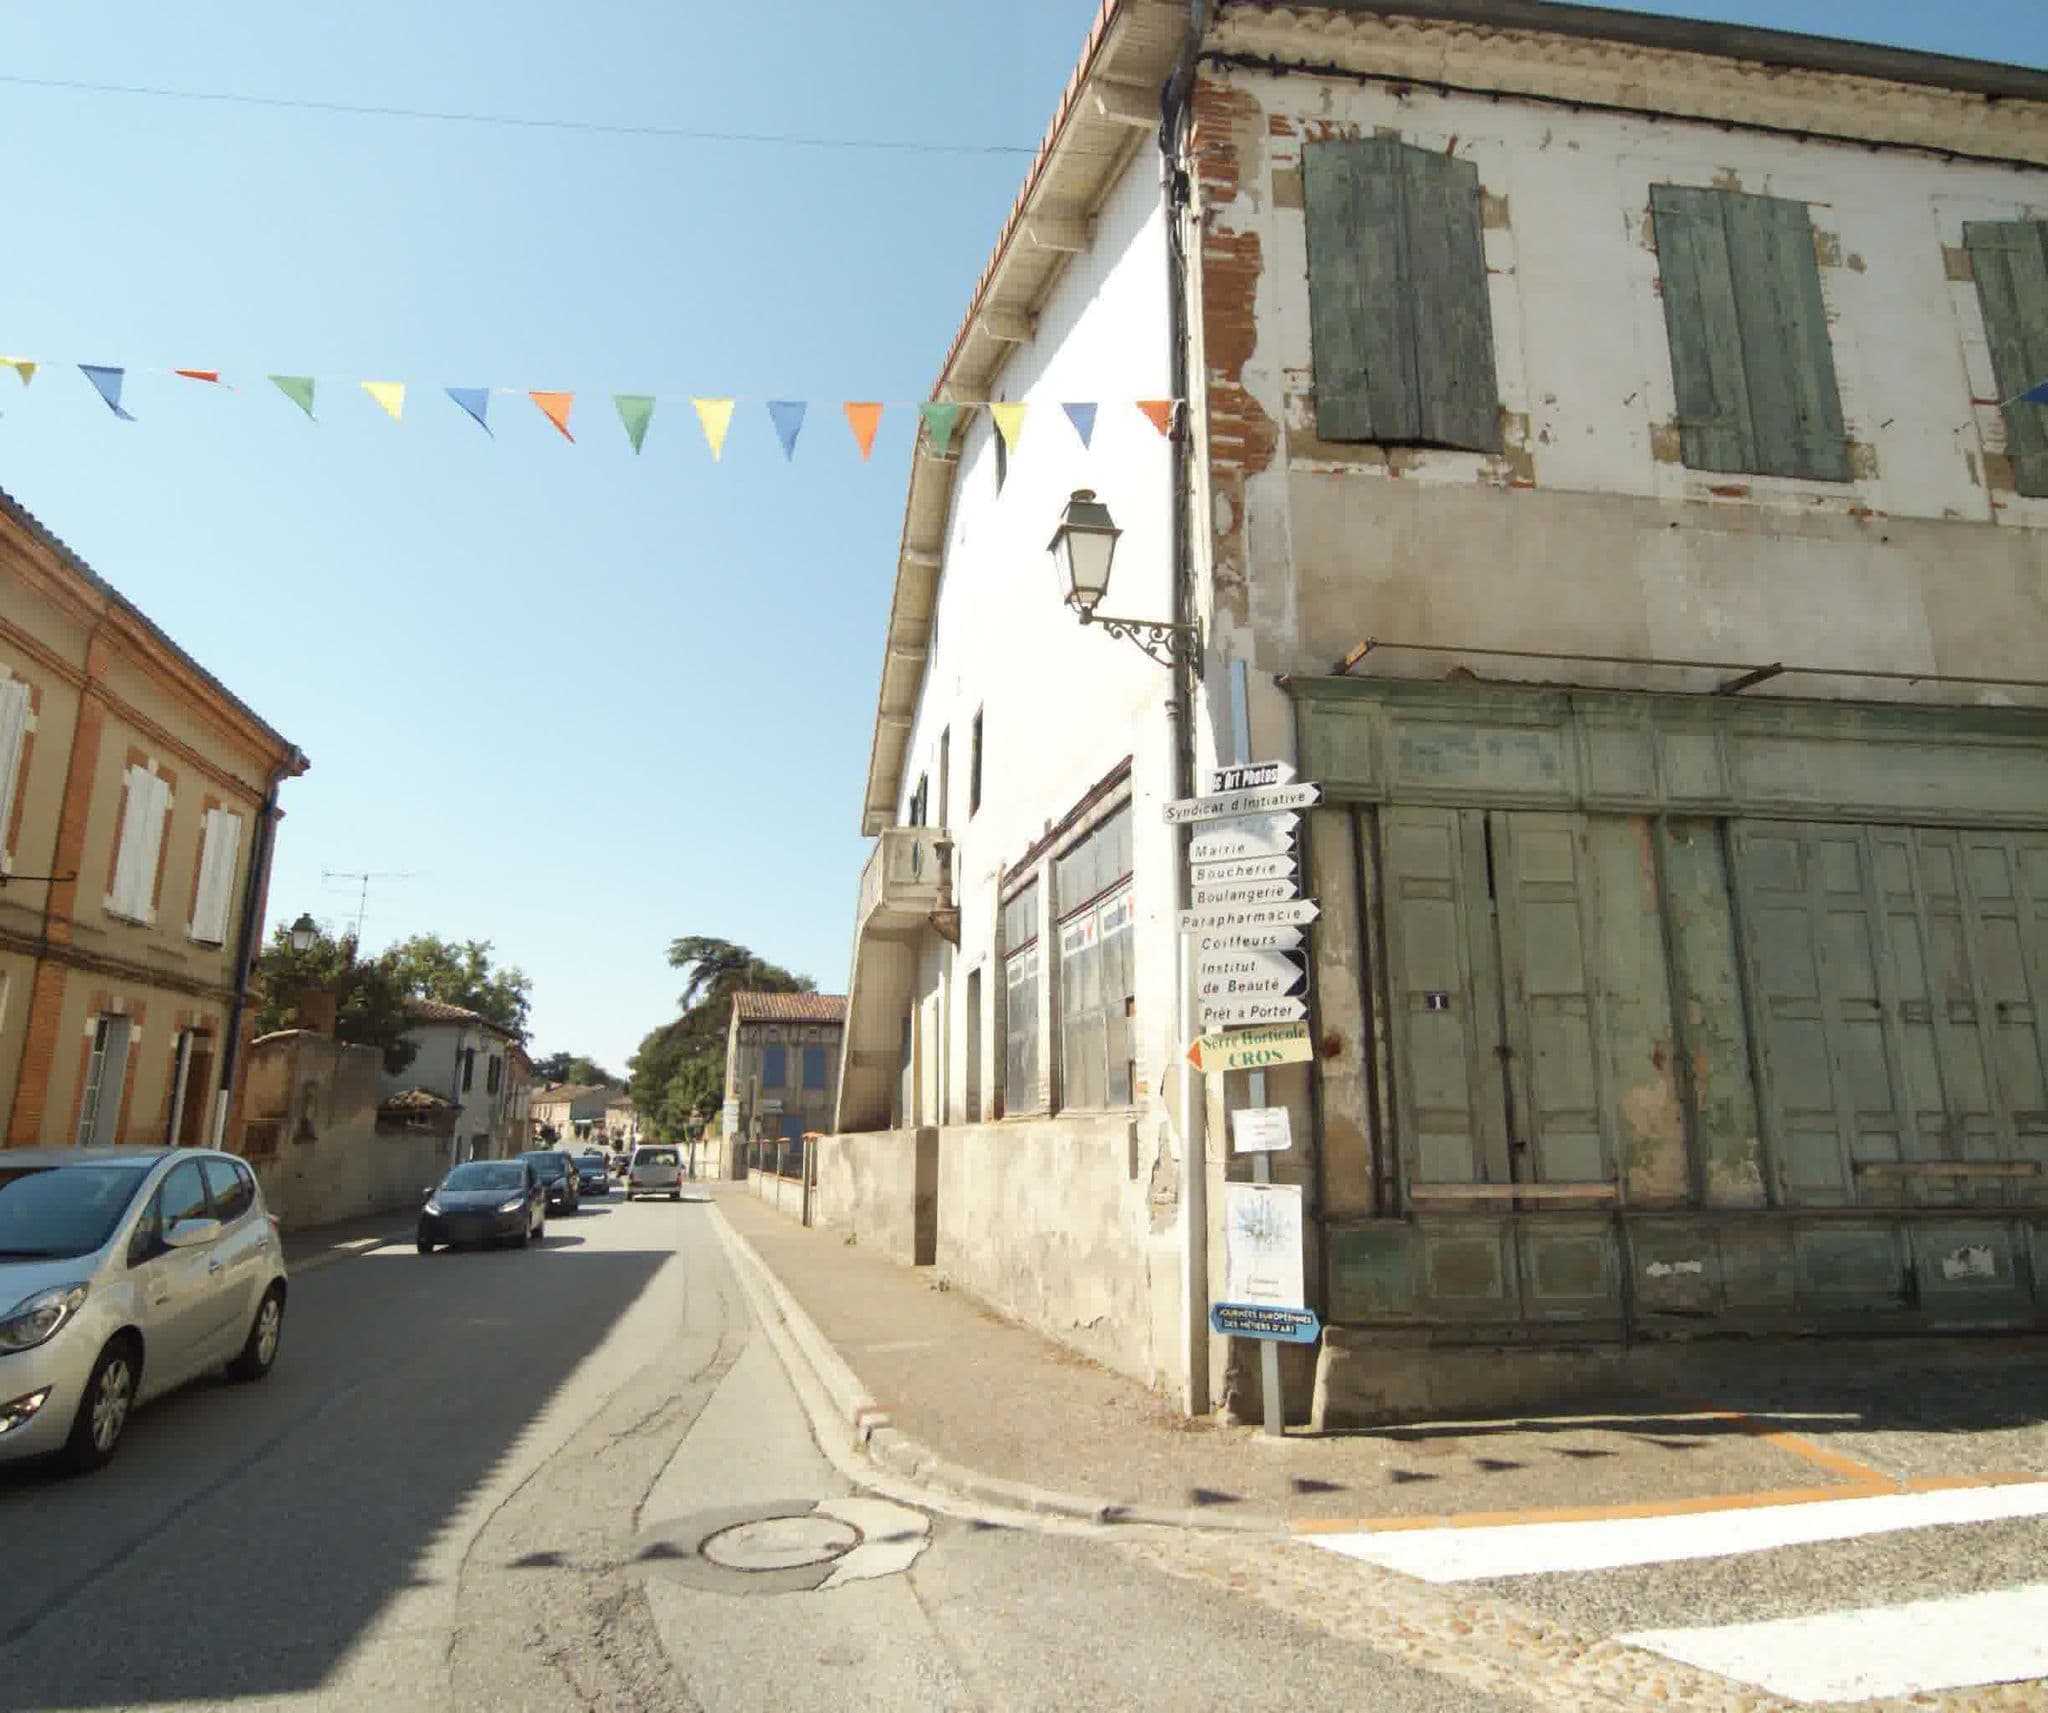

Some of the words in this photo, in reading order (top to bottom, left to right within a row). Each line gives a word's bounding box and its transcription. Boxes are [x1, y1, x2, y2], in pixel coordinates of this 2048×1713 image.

[1167, 801, 1224, 818] Syndicat
[1195, 844, 1245, 857] Mairie
[1197, 864, 1276, 881] Boucherie
[1197, 886, 1284, 904] Boulangerie
[1182, 909, 1301, 928] Parapharmacie
[1201, 935, 1277, 951] Coiffeurs
[1202, 961, 1256, 974] Institut
[1203, 982, 1219, 994] de
[1228, 978, 1279, 993] Beauté
[1251, 1005, 1292, 1018] Porter
[1229, 1049, 1283, 1067] CROS
